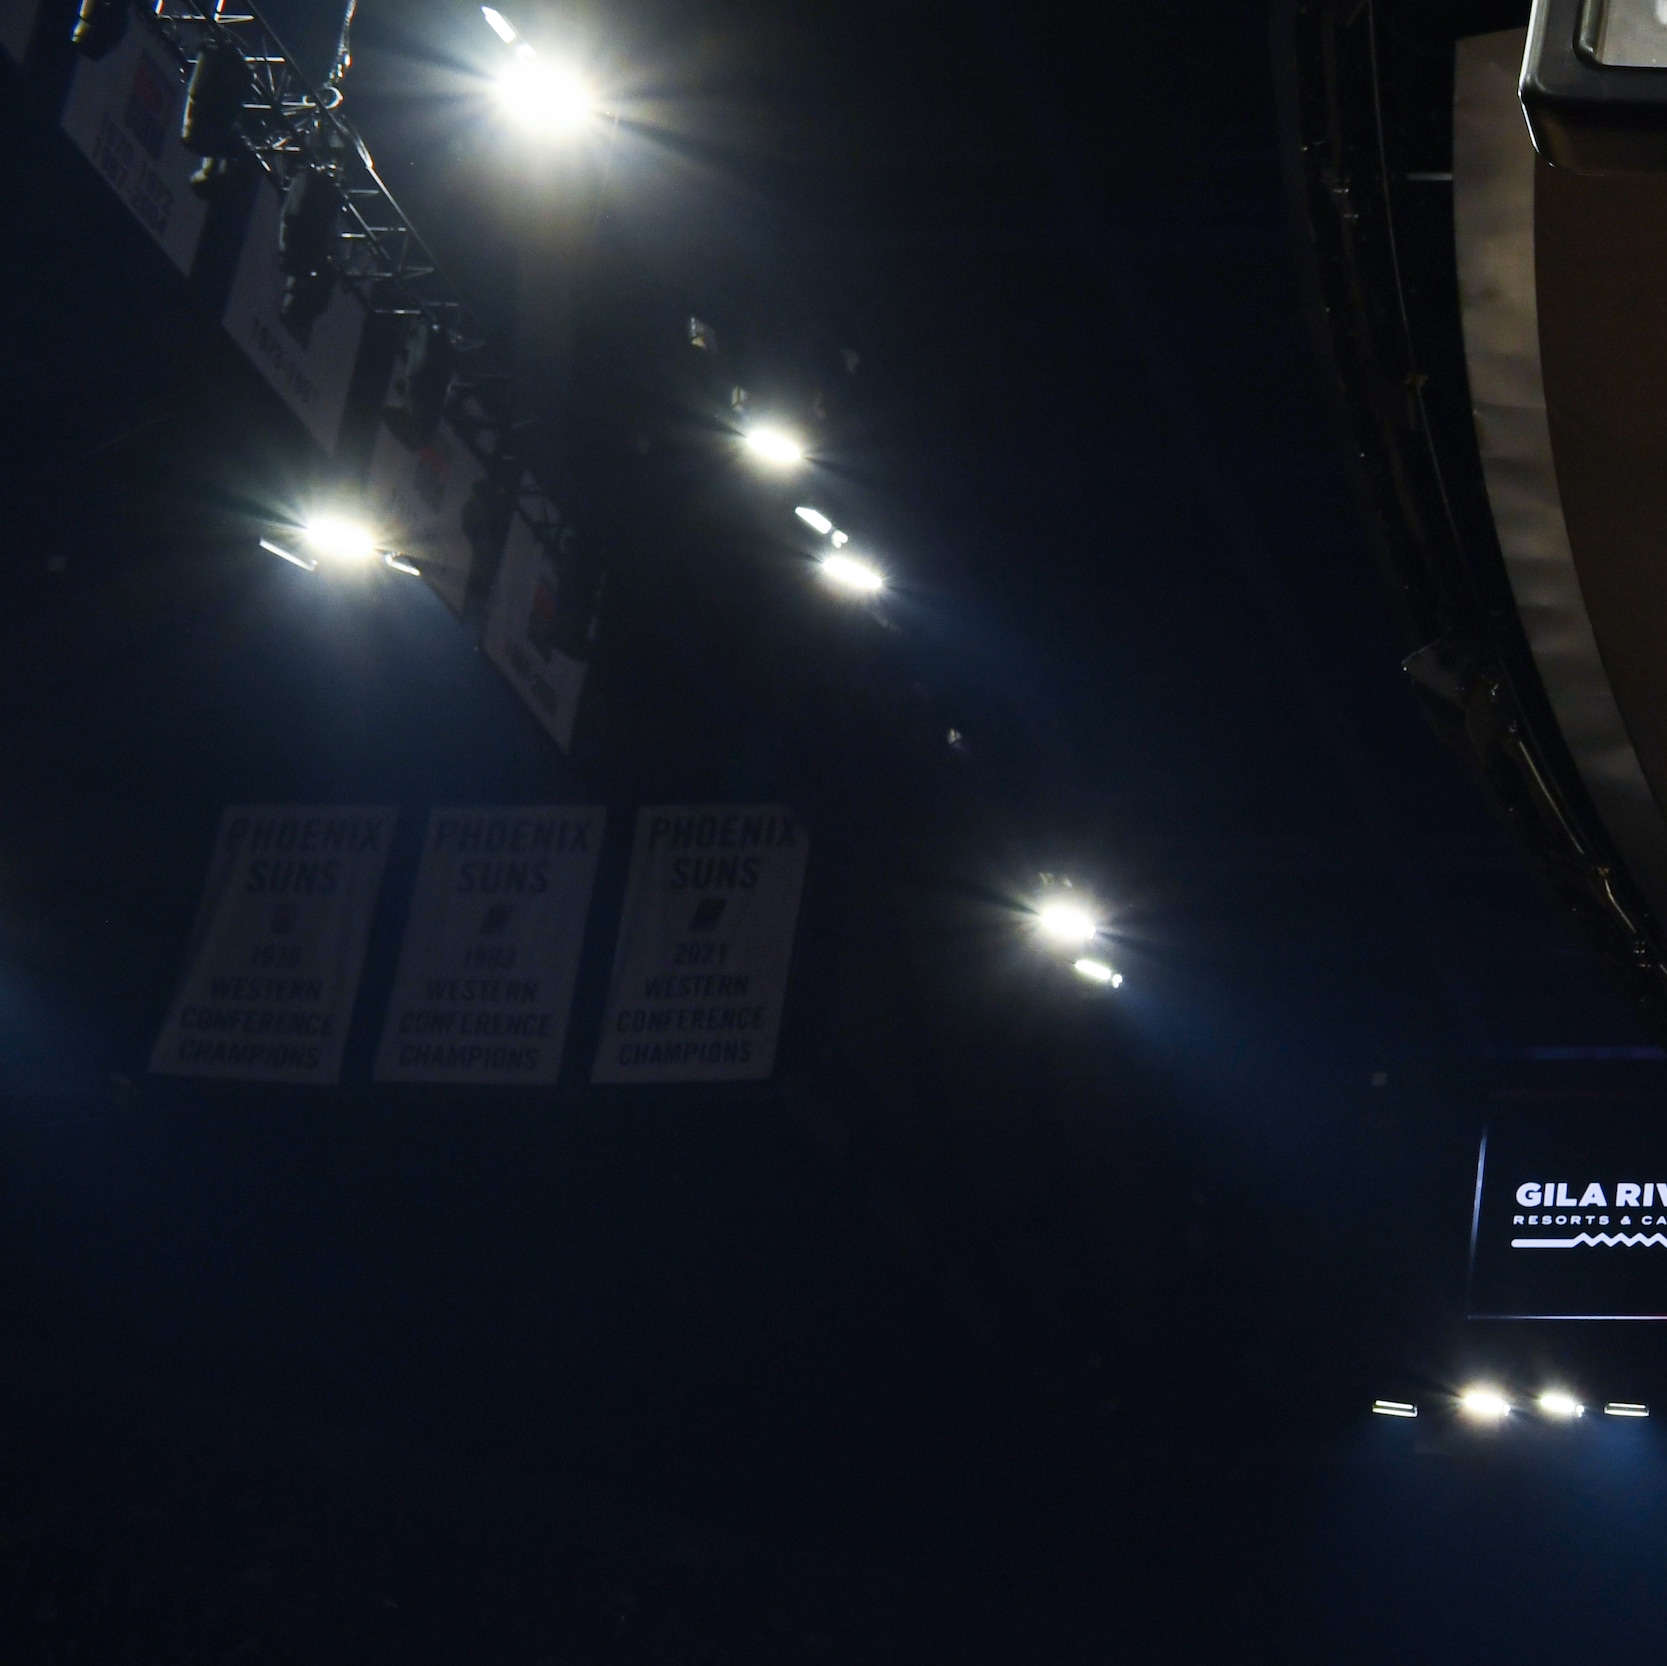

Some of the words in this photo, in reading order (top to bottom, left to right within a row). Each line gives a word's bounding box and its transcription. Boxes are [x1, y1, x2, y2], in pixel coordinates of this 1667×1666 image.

[225, 819, 384, 852] PHOENIX
[434, 820, 591, 852] PHOENIX
[648, 818, 799, 850] PHOENIX
[247, 859, 341, 892] SUNS
[456, 861, 550, 893] SUNS
[669, 856, 759, 889] SUNS
[645, 975, 748, 997] WESTERN
[617, 1006, 763, 1031] CONFERENCE
[619, 1039, 751, 1065] CHAMPIONS
[1516, 1182, 1607, 1207] GILA
[1513, 1215, 1609, 1225] RESORTS
[1621, 1216, 1631, 1225] &
